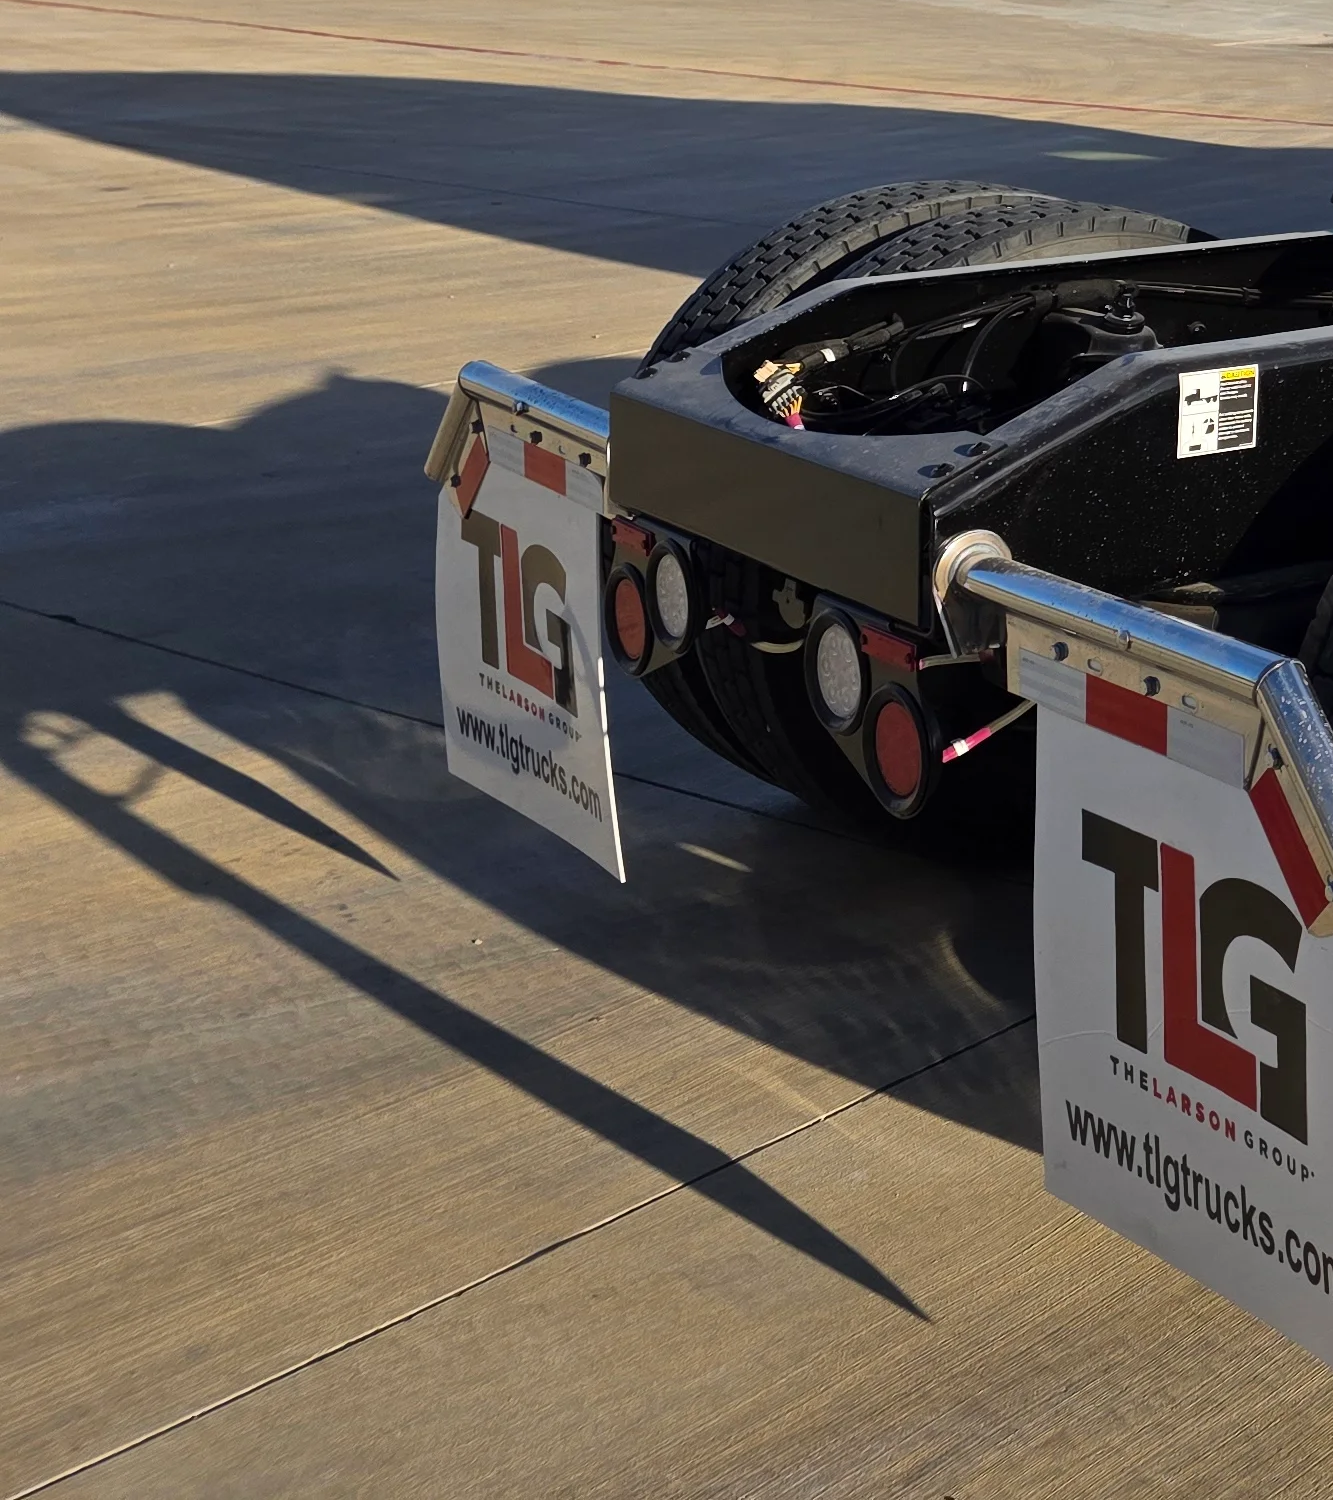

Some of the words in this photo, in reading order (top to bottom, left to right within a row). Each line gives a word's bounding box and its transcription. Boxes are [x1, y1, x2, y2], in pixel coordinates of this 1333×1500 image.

[461, 509, 578, 718] TLG
[456, 706, 602, 823] www.tlgtrucks.com
[548, 712, 581, 742] GROUP
[1081, 809, 1308, 1145] TLG
[1244, 1129, 1310, 1182] GROUP
